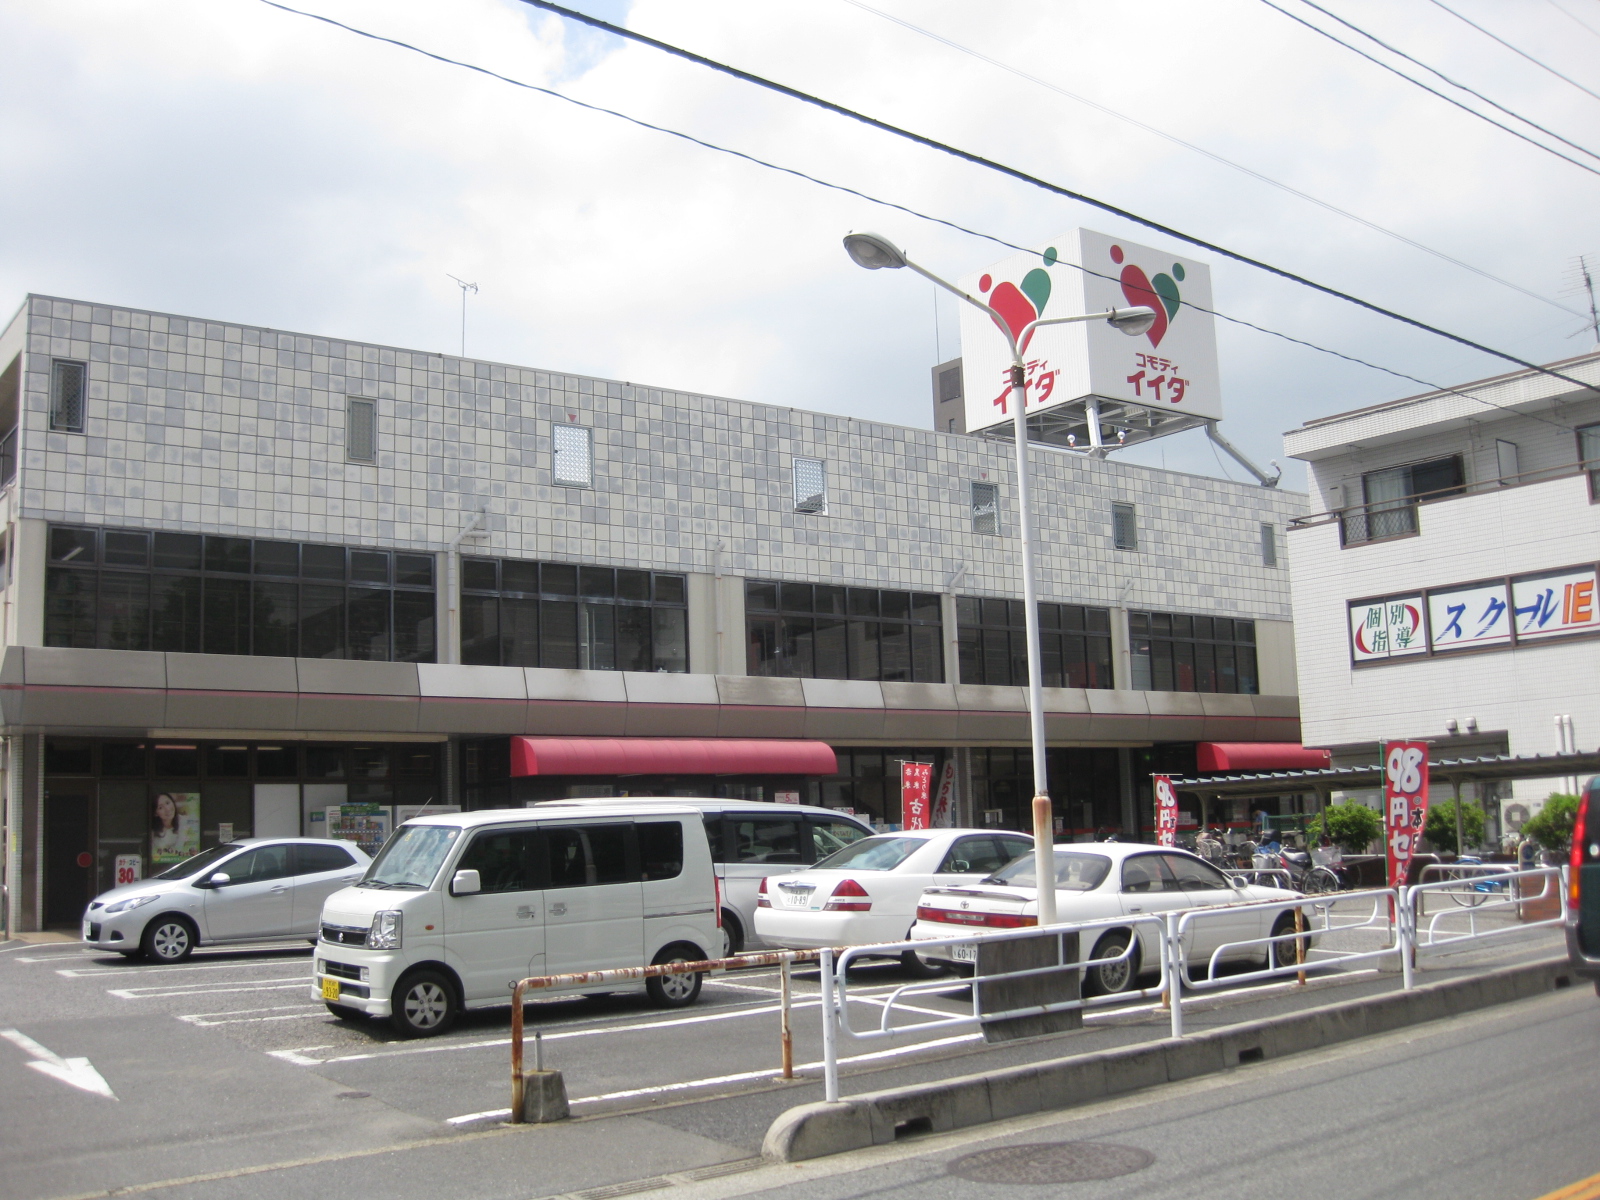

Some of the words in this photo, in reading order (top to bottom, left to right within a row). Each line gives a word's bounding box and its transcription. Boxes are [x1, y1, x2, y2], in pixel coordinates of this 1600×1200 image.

[1002, 359, 1048, 384] コディ
[1135, 352, 1178, 375] コモディ
[1127, 370, 1190, 403] イイダ
[1366, 603, 1405, 629] 個別
[1372, 626, 1416, 652] 指導
